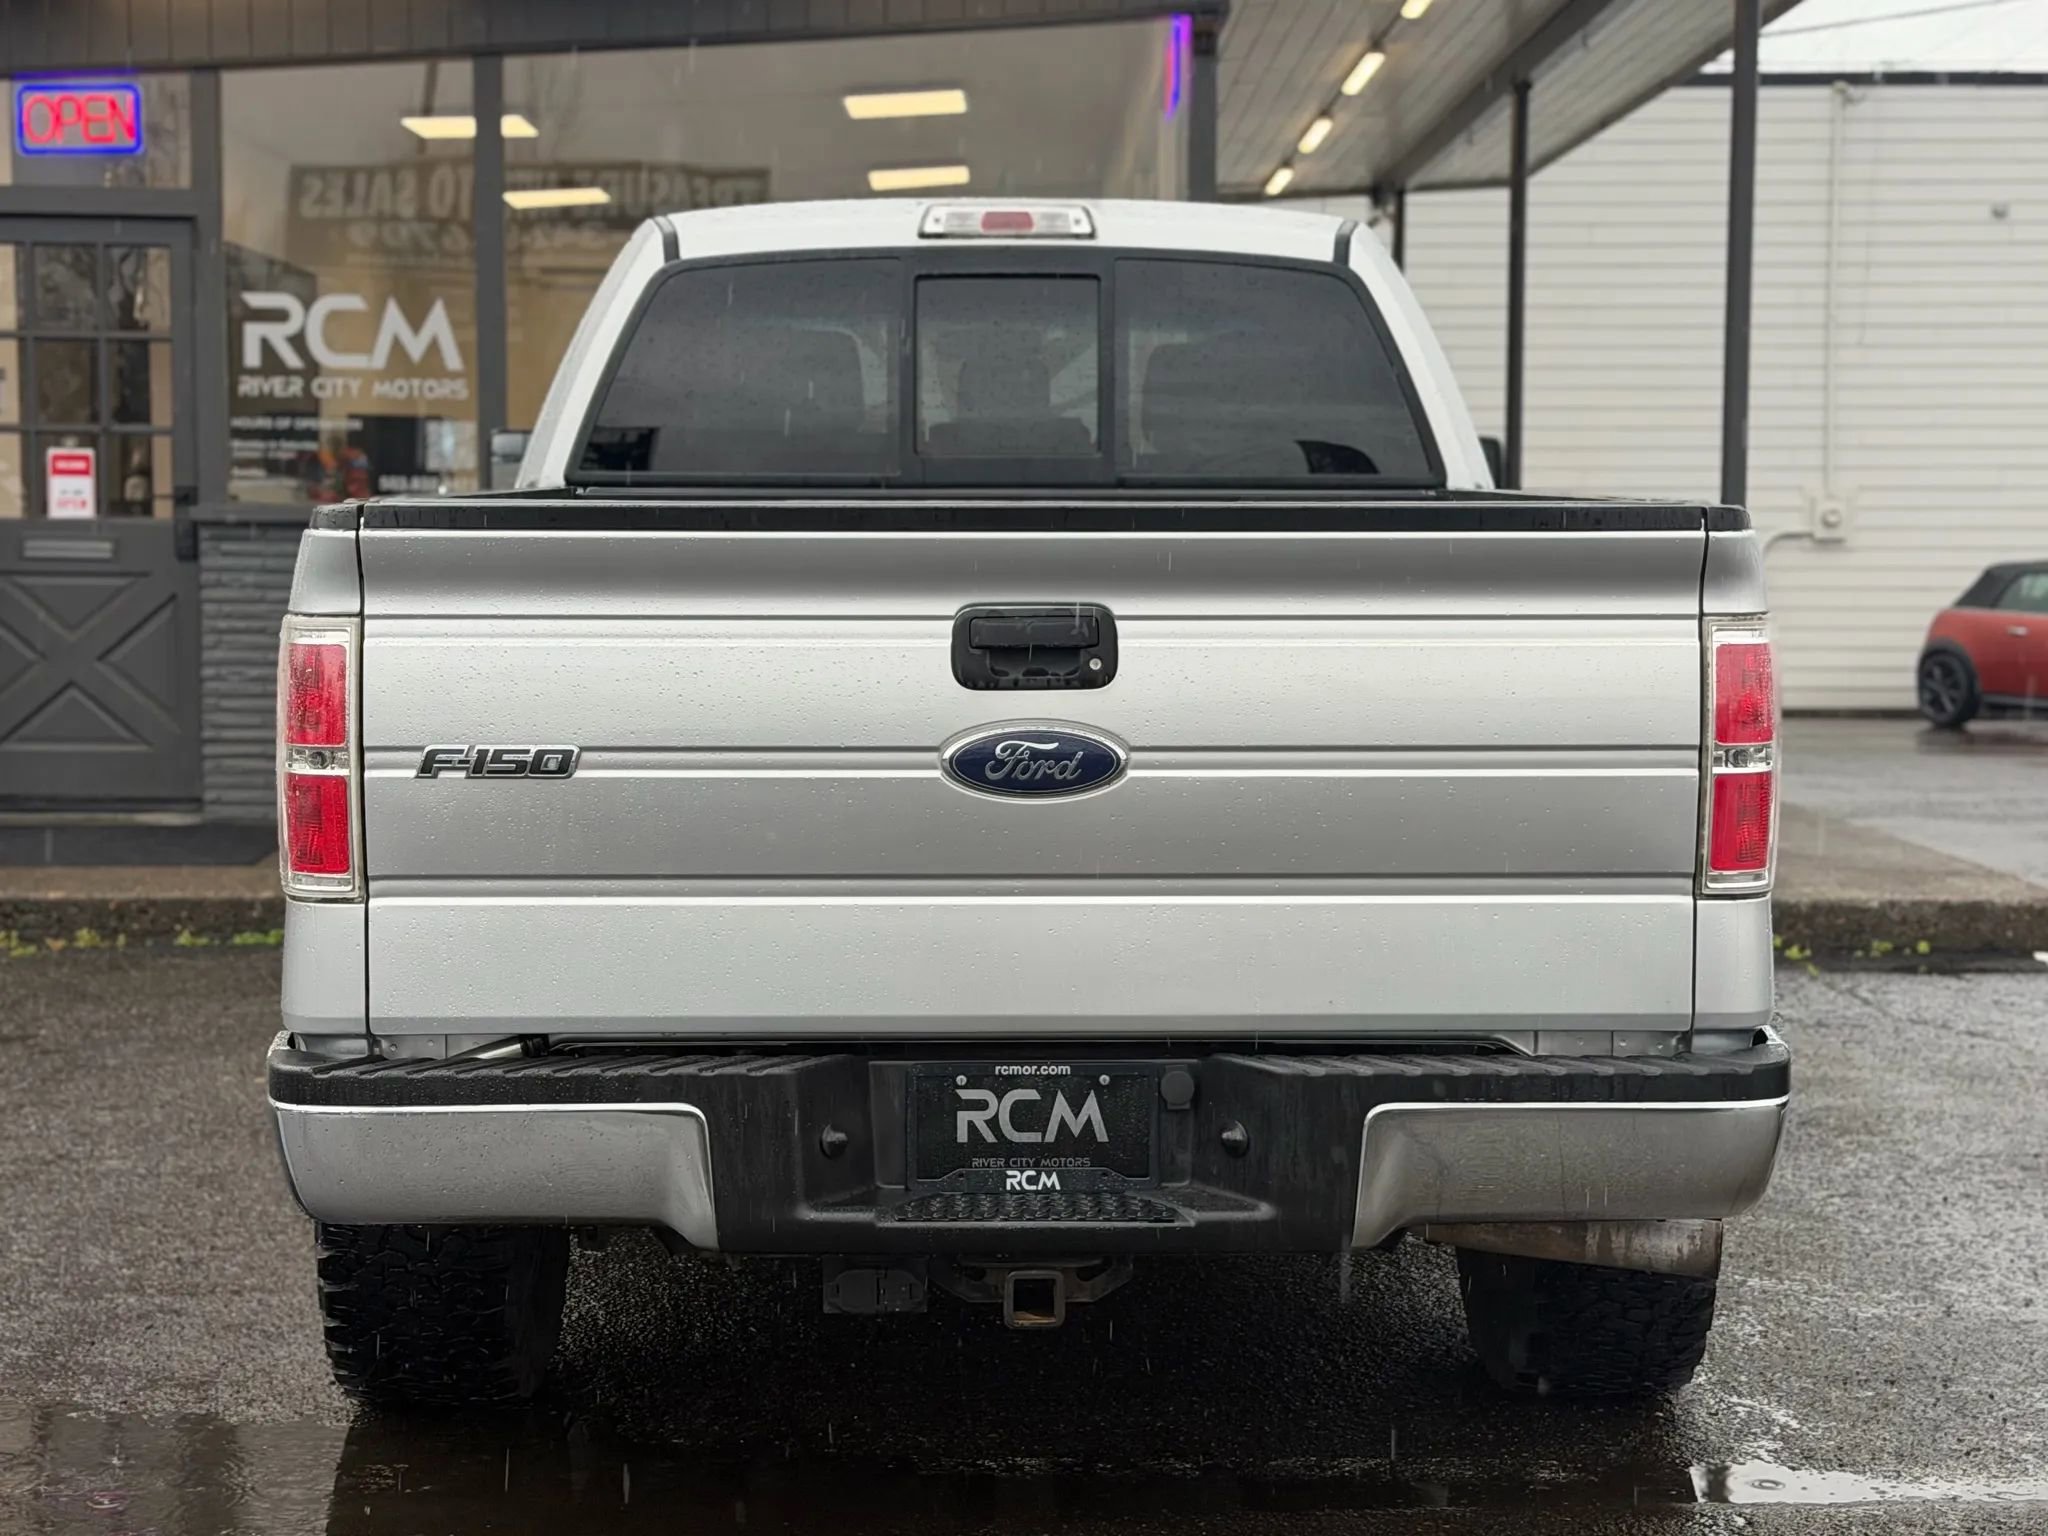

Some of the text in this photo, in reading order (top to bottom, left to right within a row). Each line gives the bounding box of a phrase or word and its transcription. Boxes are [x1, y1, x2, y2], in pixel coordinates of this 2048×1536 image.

[22, 93, 136, 144] OPEN
[241, 291, 464, 371] RCM
[238, 376, 469, 398] RIVER CITY MOTORS
[414, 744, 582, 779] F-150
[985, 740, 1084, 780] Ford
[995, 1065, 1071, 1075] rcmor.com
[955, 1089, 1110, 1143] RCM
[972, 1158, 1091, 1168] RIVER CITY MOTORS
[1005, 1170, 1061, 1191] RCM
